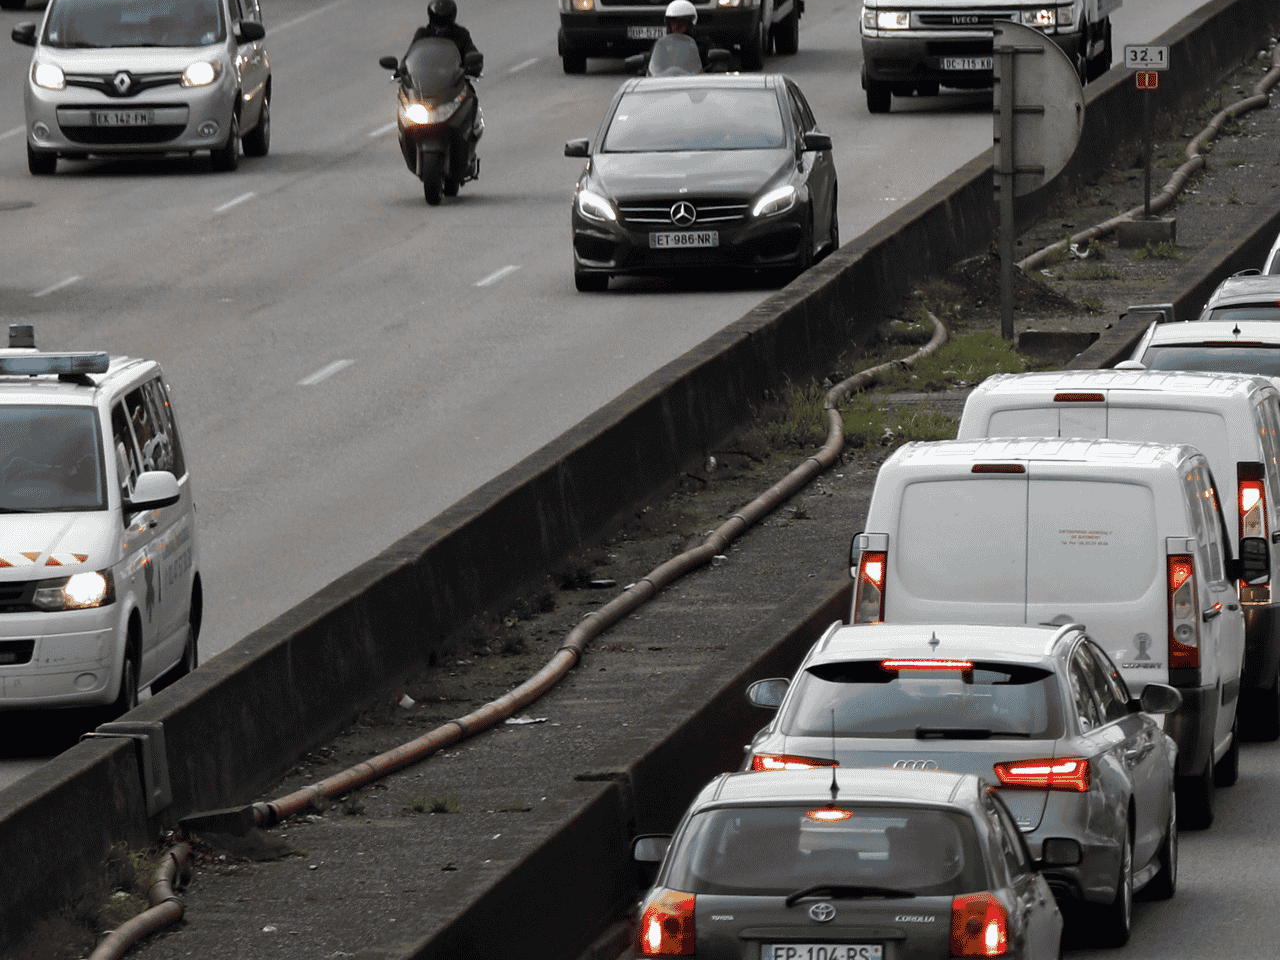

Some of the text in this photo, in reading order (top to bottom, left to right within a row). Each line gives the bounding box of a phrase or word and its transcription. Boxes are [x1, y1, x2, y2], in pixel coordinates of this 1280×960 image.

[952, 16, 979, 25] IVECO
[1130, 49, 1164, 62] 32.1
[657, 232, 711, 246] ET-986-NR
[895, 915, 935, 923] COROLLA
